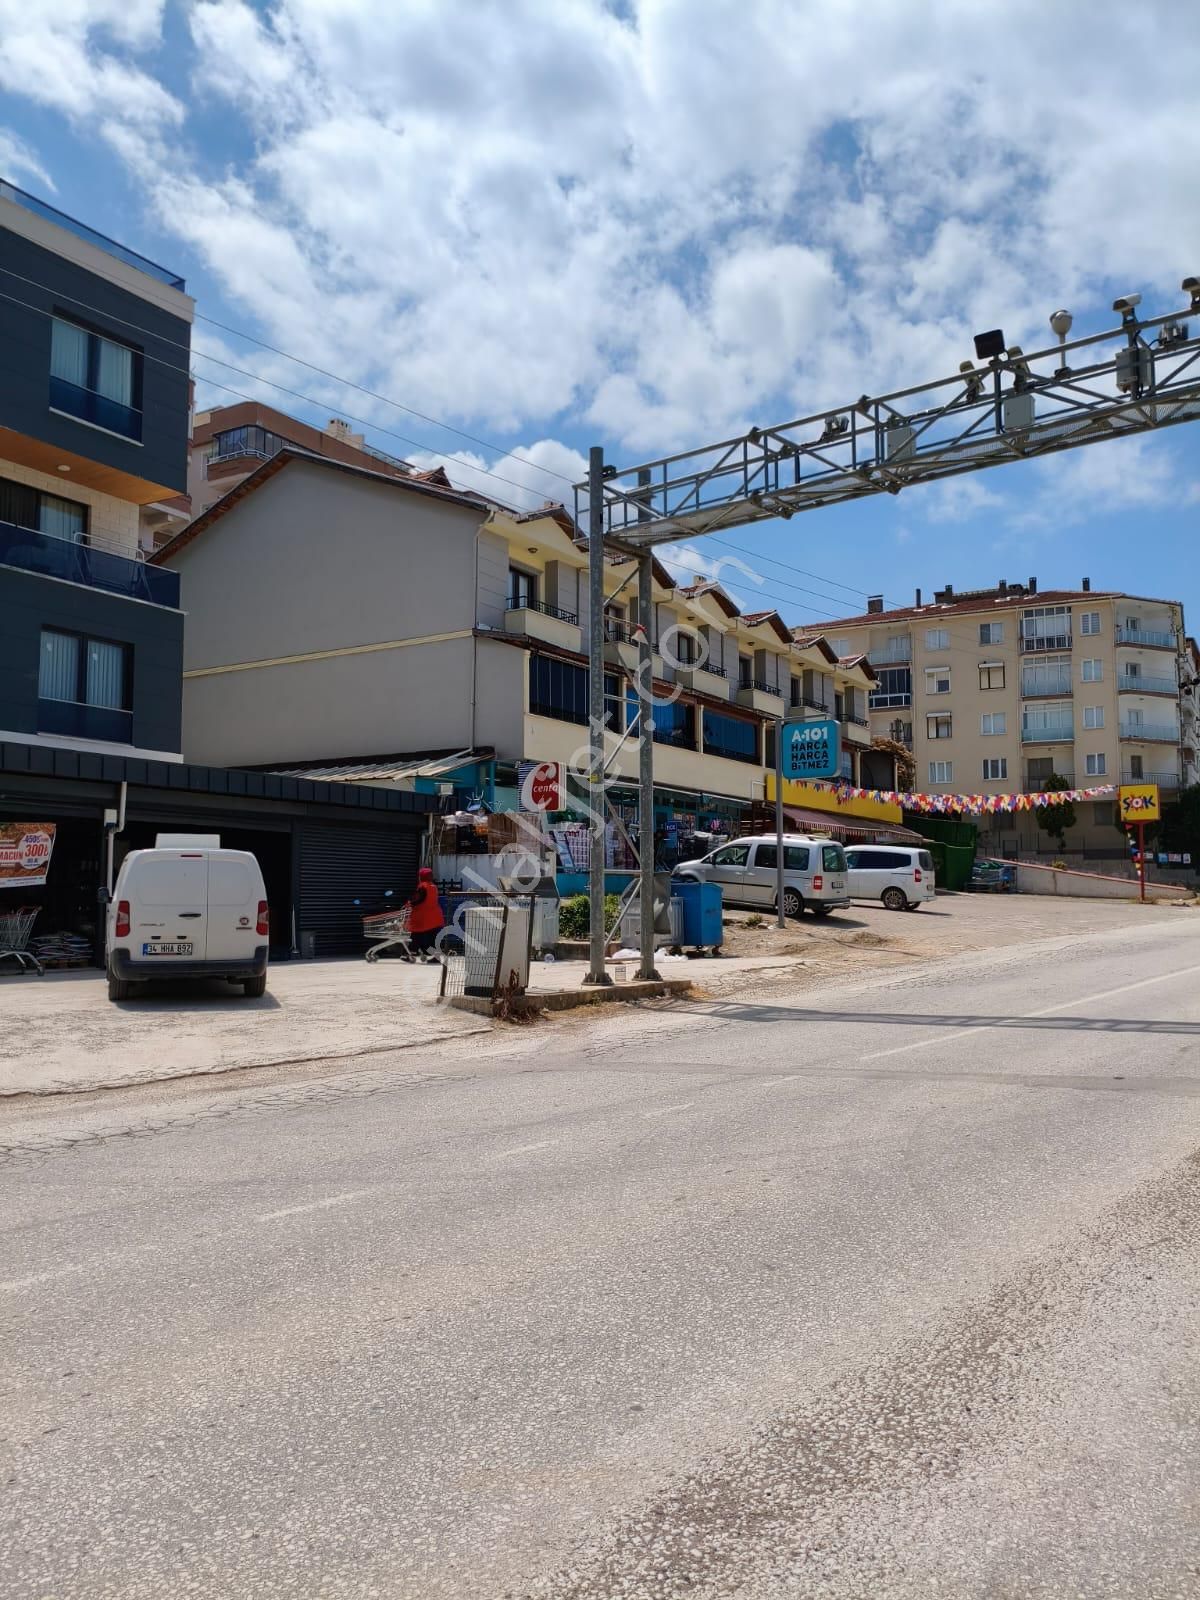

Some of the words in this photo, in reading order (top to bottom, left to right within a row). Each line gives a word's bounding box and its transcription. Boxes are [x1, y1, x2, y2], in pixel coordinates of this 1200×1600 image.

[791, 740, 829, 752] HARCA
[791, 750, 829, 762] HARCA
[148, 945, 157, 953] 34
[161, 944, 174, 953] HHA
[177, 944, 191, 953] 892
